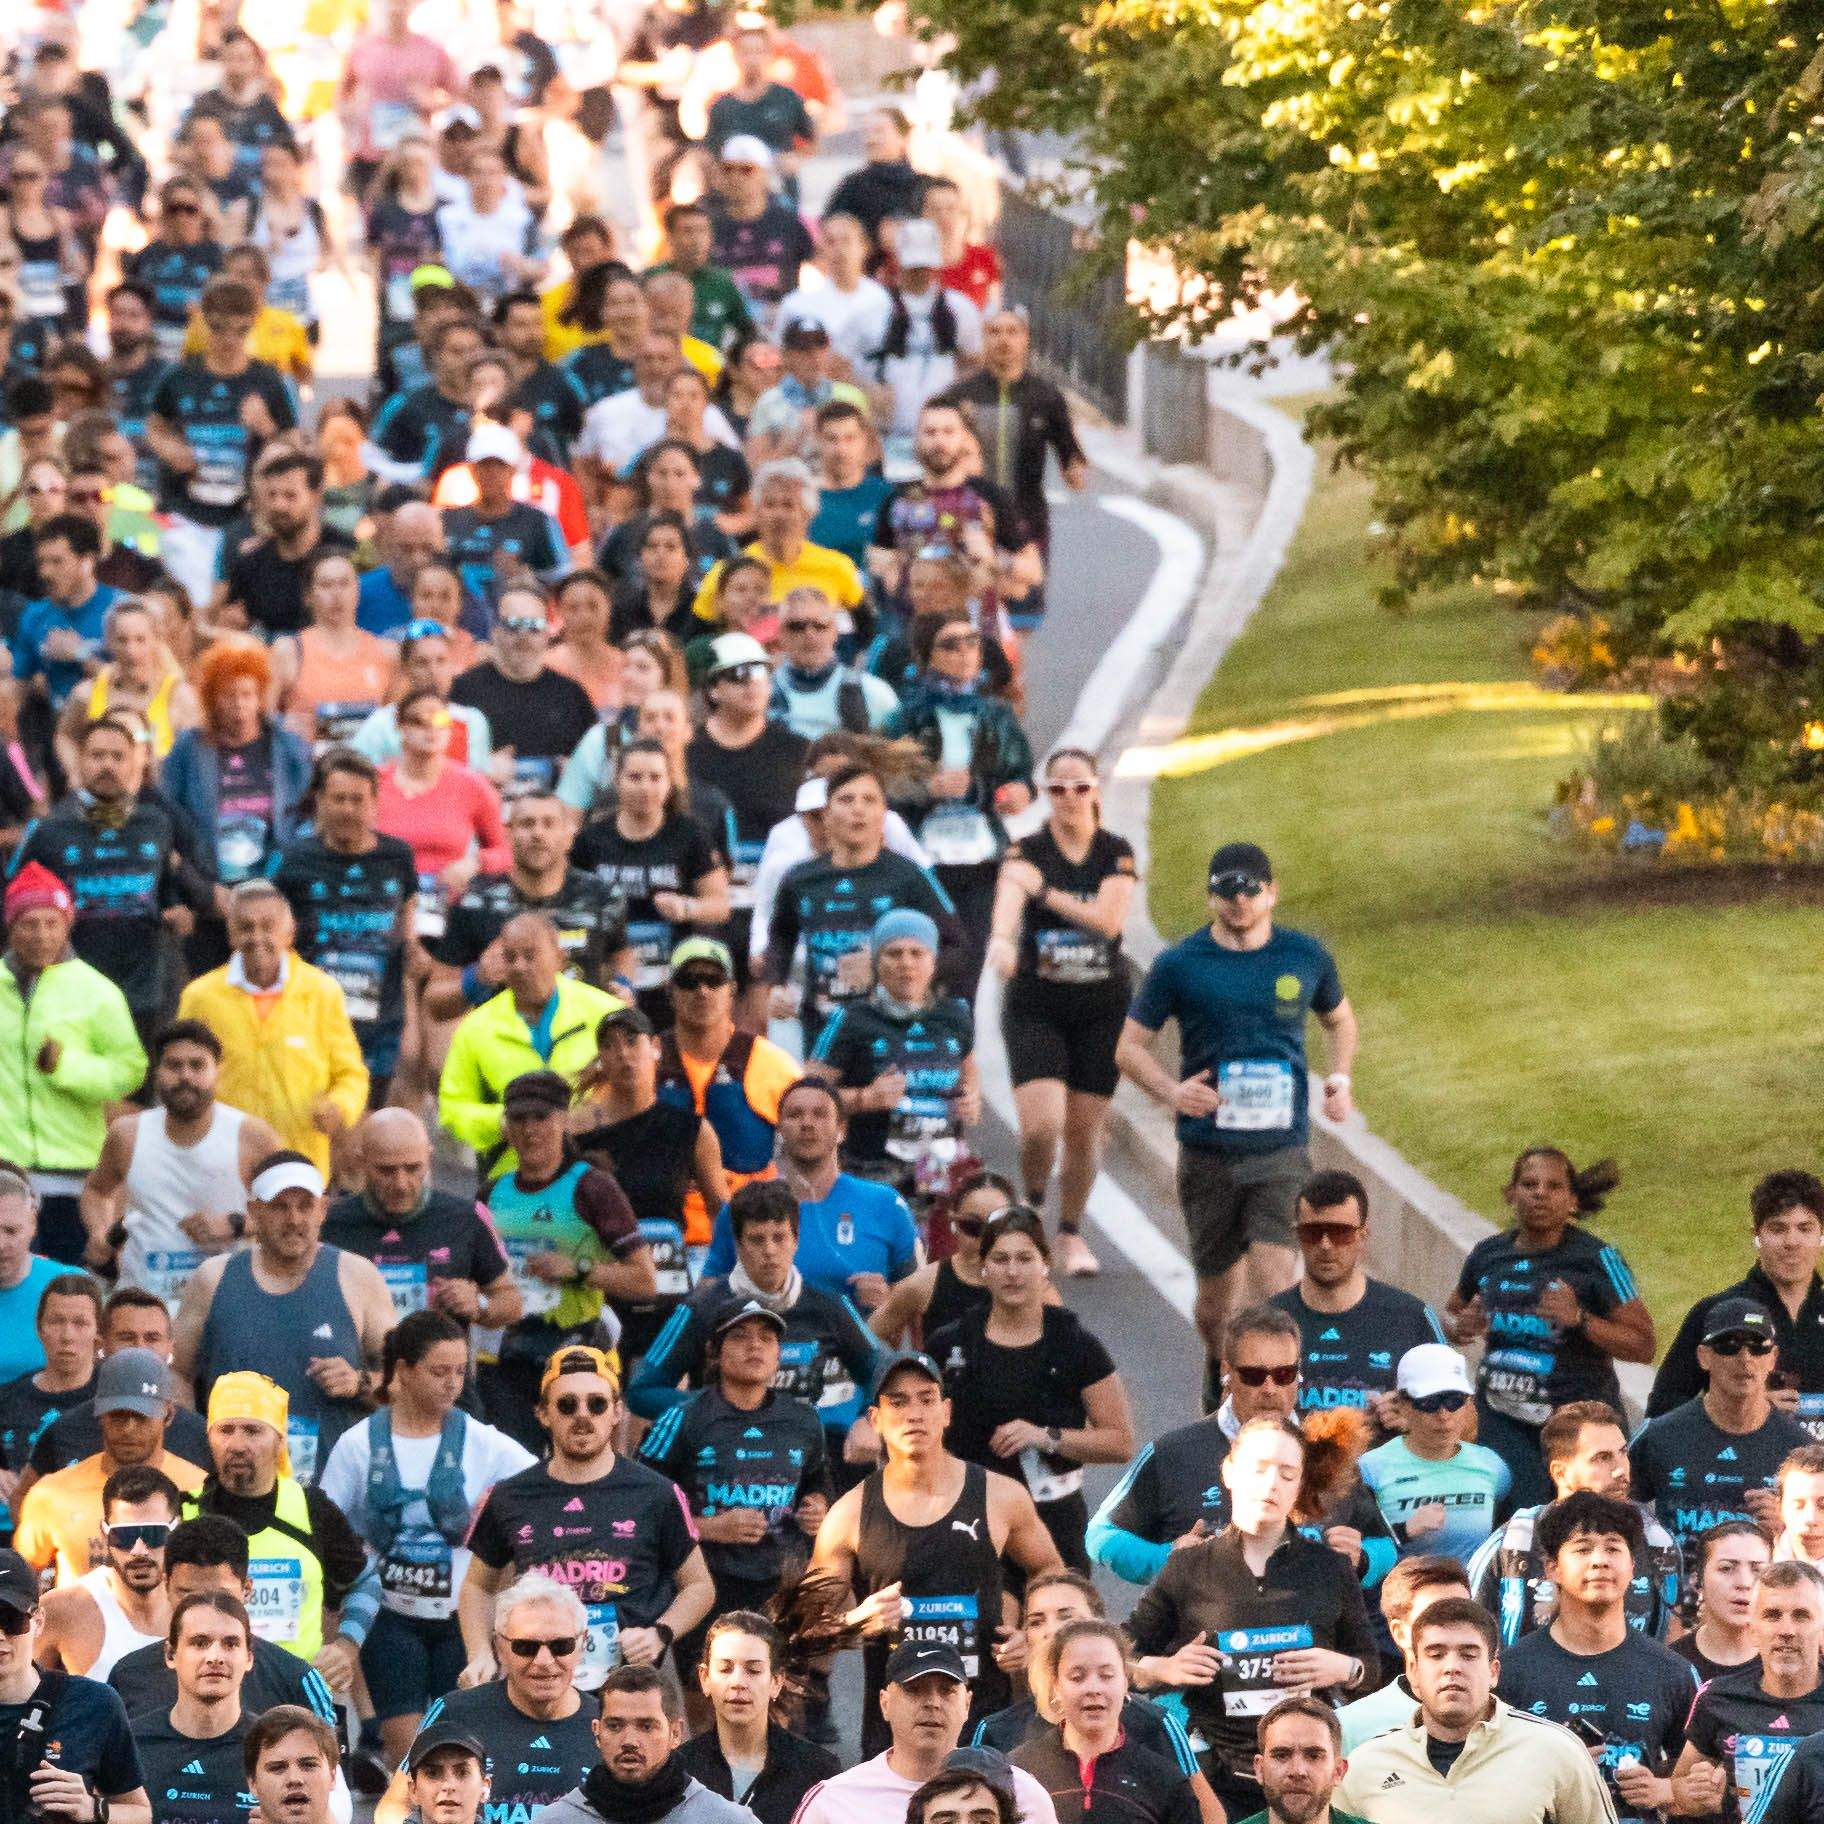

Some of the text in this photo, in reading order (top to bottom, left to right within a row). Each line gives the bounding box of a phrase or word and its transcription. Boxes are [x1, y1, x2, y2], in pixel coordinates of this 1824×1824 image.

[918, 1602, 964, 1614] ZURICH
[904, 1626, 960, 1644] 31954
[1251, 1631, 1298, 1645] ZURICH
[1238, 1658, 1273, 1679] 375
